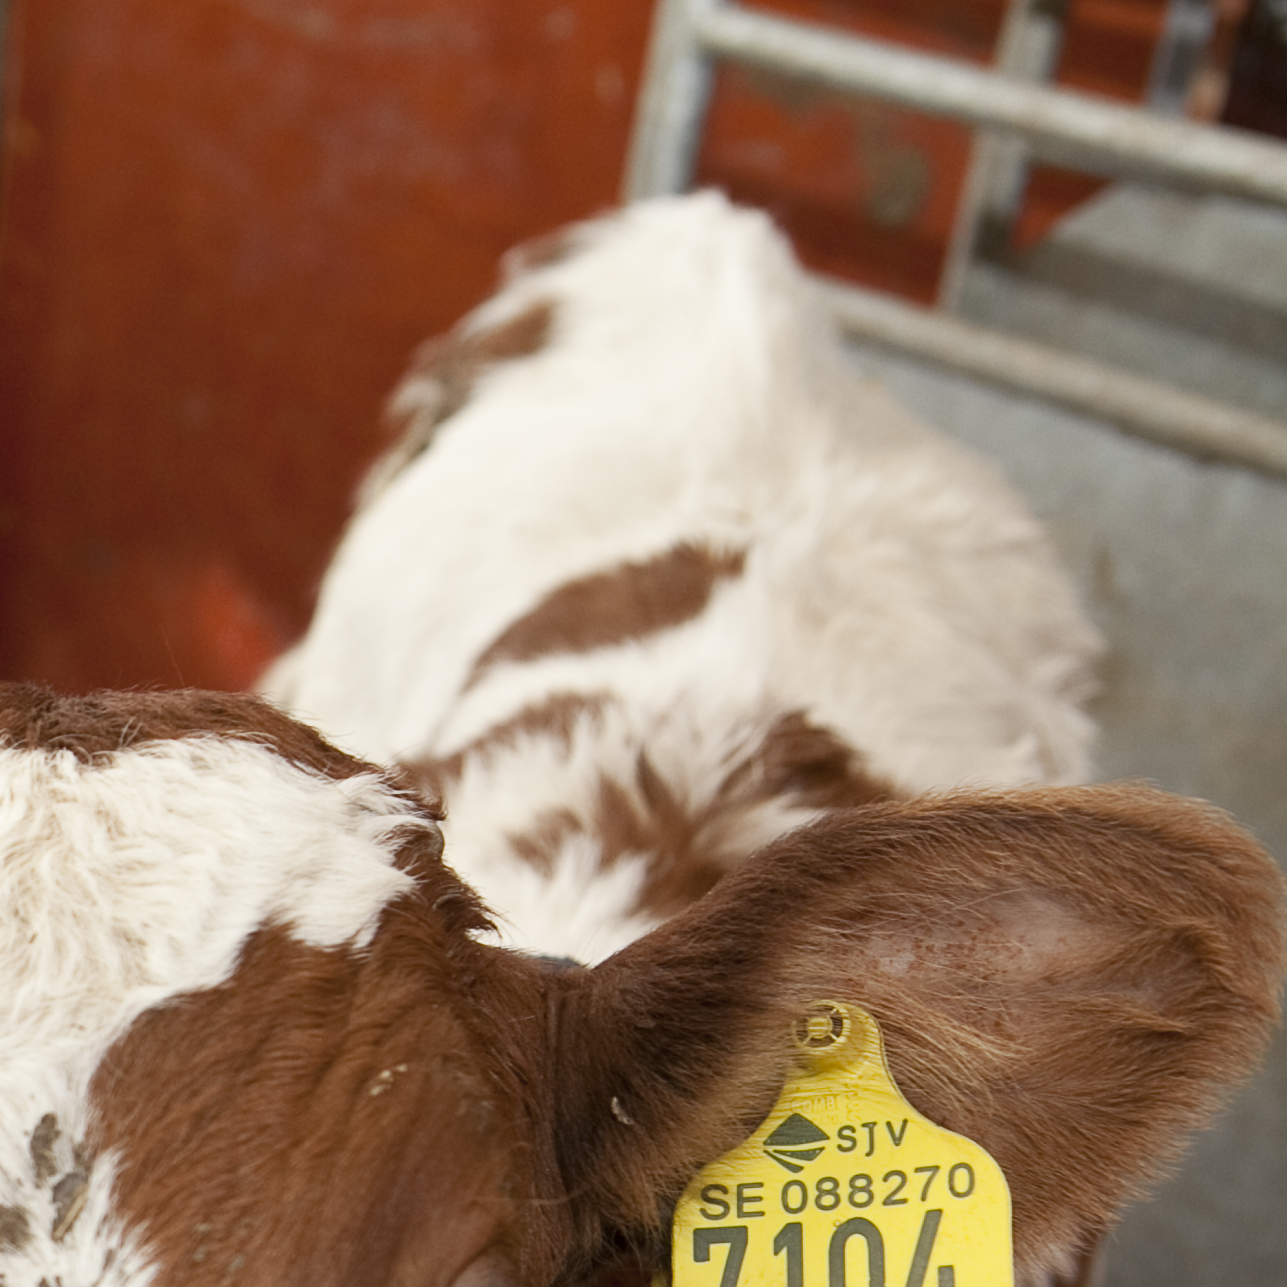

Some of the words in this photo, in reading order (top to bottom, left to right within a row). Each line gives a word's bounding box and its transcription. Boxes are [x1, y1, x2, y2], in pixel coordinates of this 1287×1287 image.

[837, 1118, 908, 1157] SJV
[699, 1182, 765, 1220] SE
[781, 1163, 975, 1214] 088270
